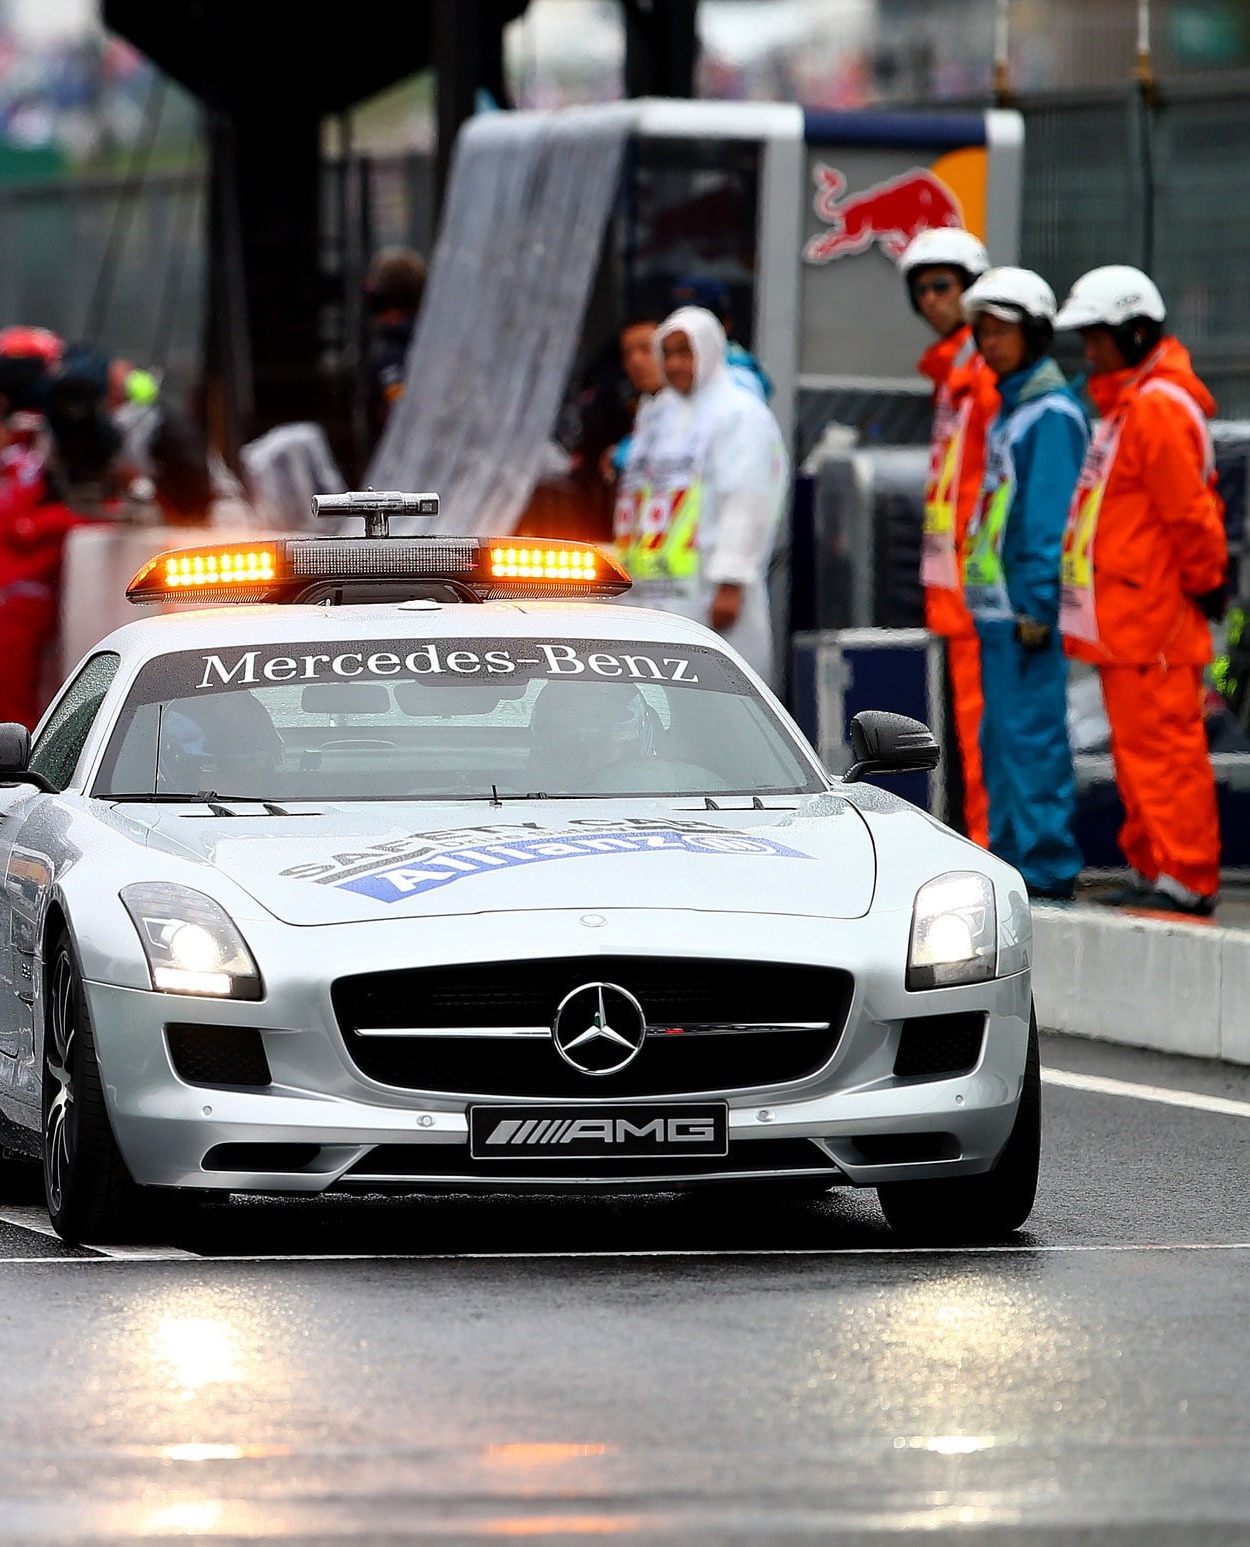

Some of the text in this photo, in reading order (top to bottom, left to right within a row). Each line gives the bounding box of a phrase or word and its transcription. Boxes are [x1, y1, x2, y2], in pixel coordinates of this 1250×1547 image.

[195, 643, 699, 688] Mercedes-Benz
[278, 817, 727, 879] SAFETY CAR
[376, 833, 686, 893] Allianz
[559, 1118, 714, 1144] AMG
